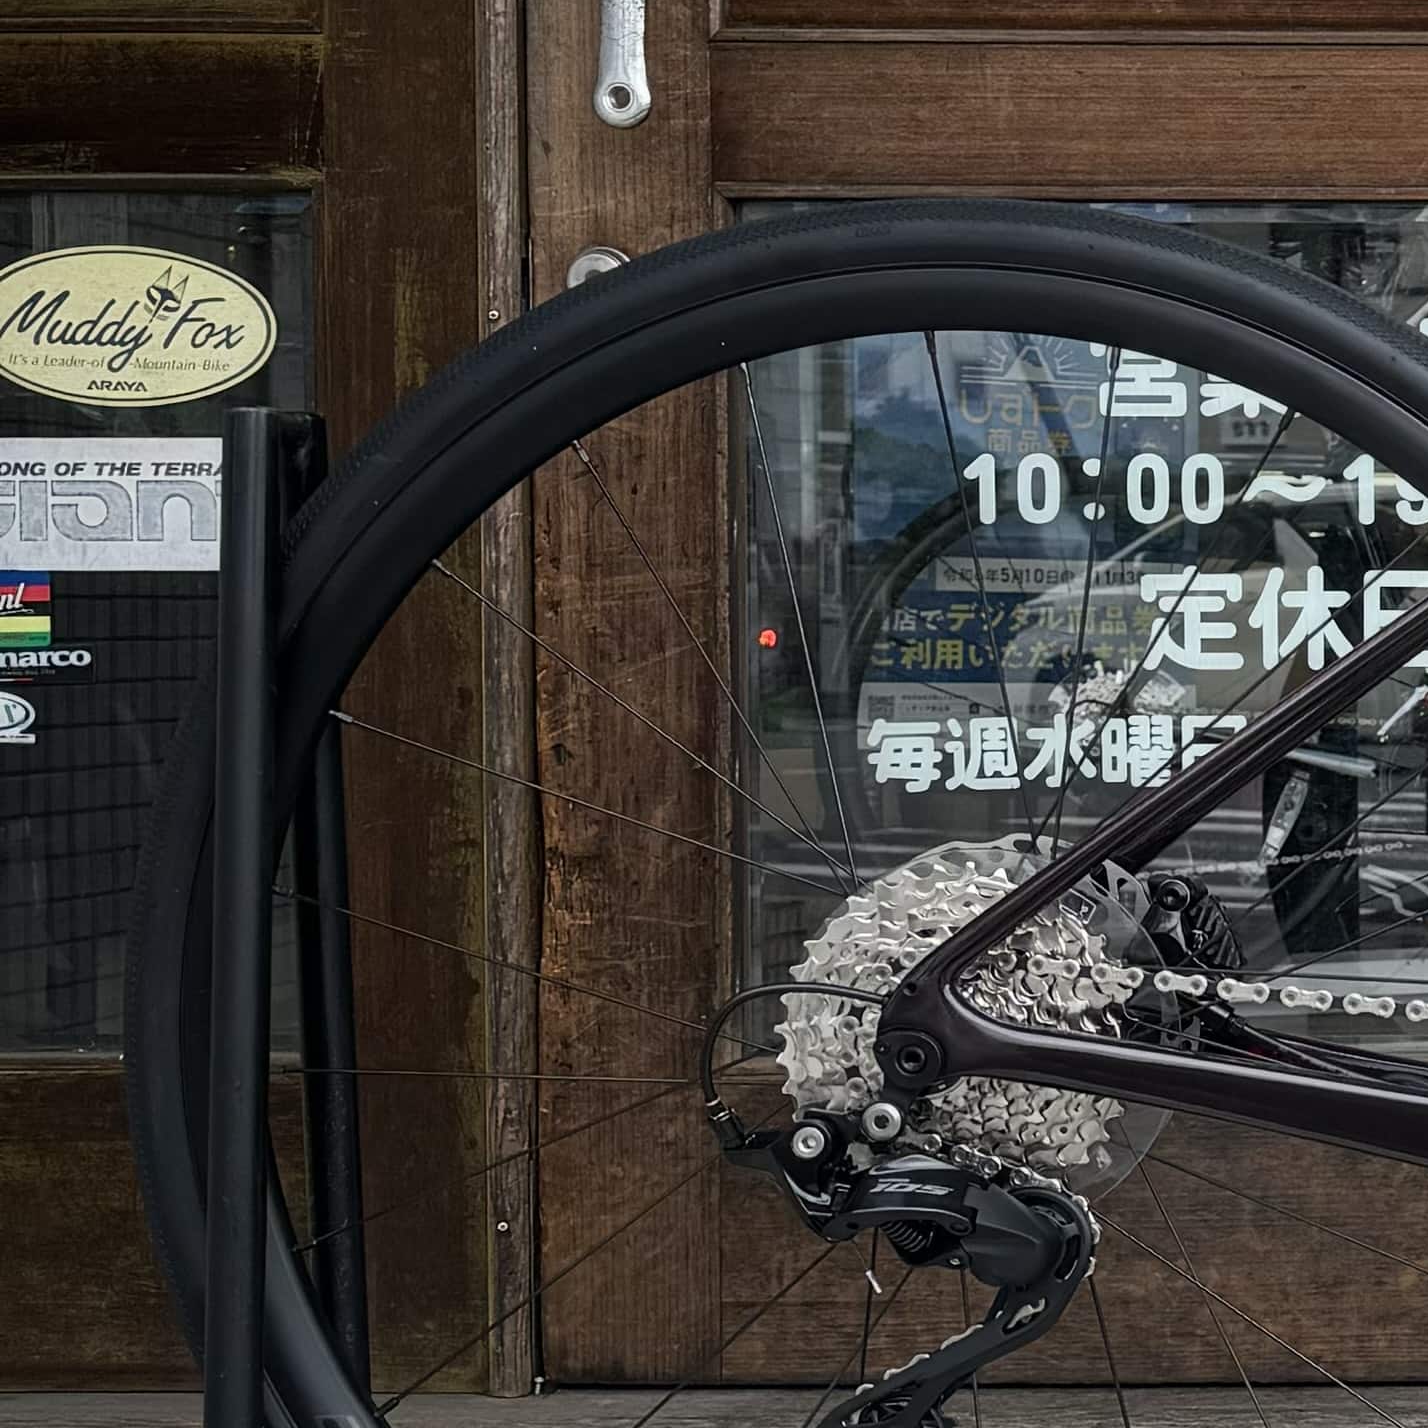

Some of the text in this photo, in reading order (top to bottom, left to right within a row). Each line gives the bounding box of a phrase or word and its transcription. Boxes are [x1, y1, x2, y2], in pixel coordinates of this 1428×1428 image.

[0, 290, 245, 373] Muddy Fox
[31, 356, 40, 367] a
[87, 380, 148, 392] ARAYA
[54, 462, 86, 476] OF
[94, 462, 142, 476] THE
[869, 1181, 954, 1196] 105
